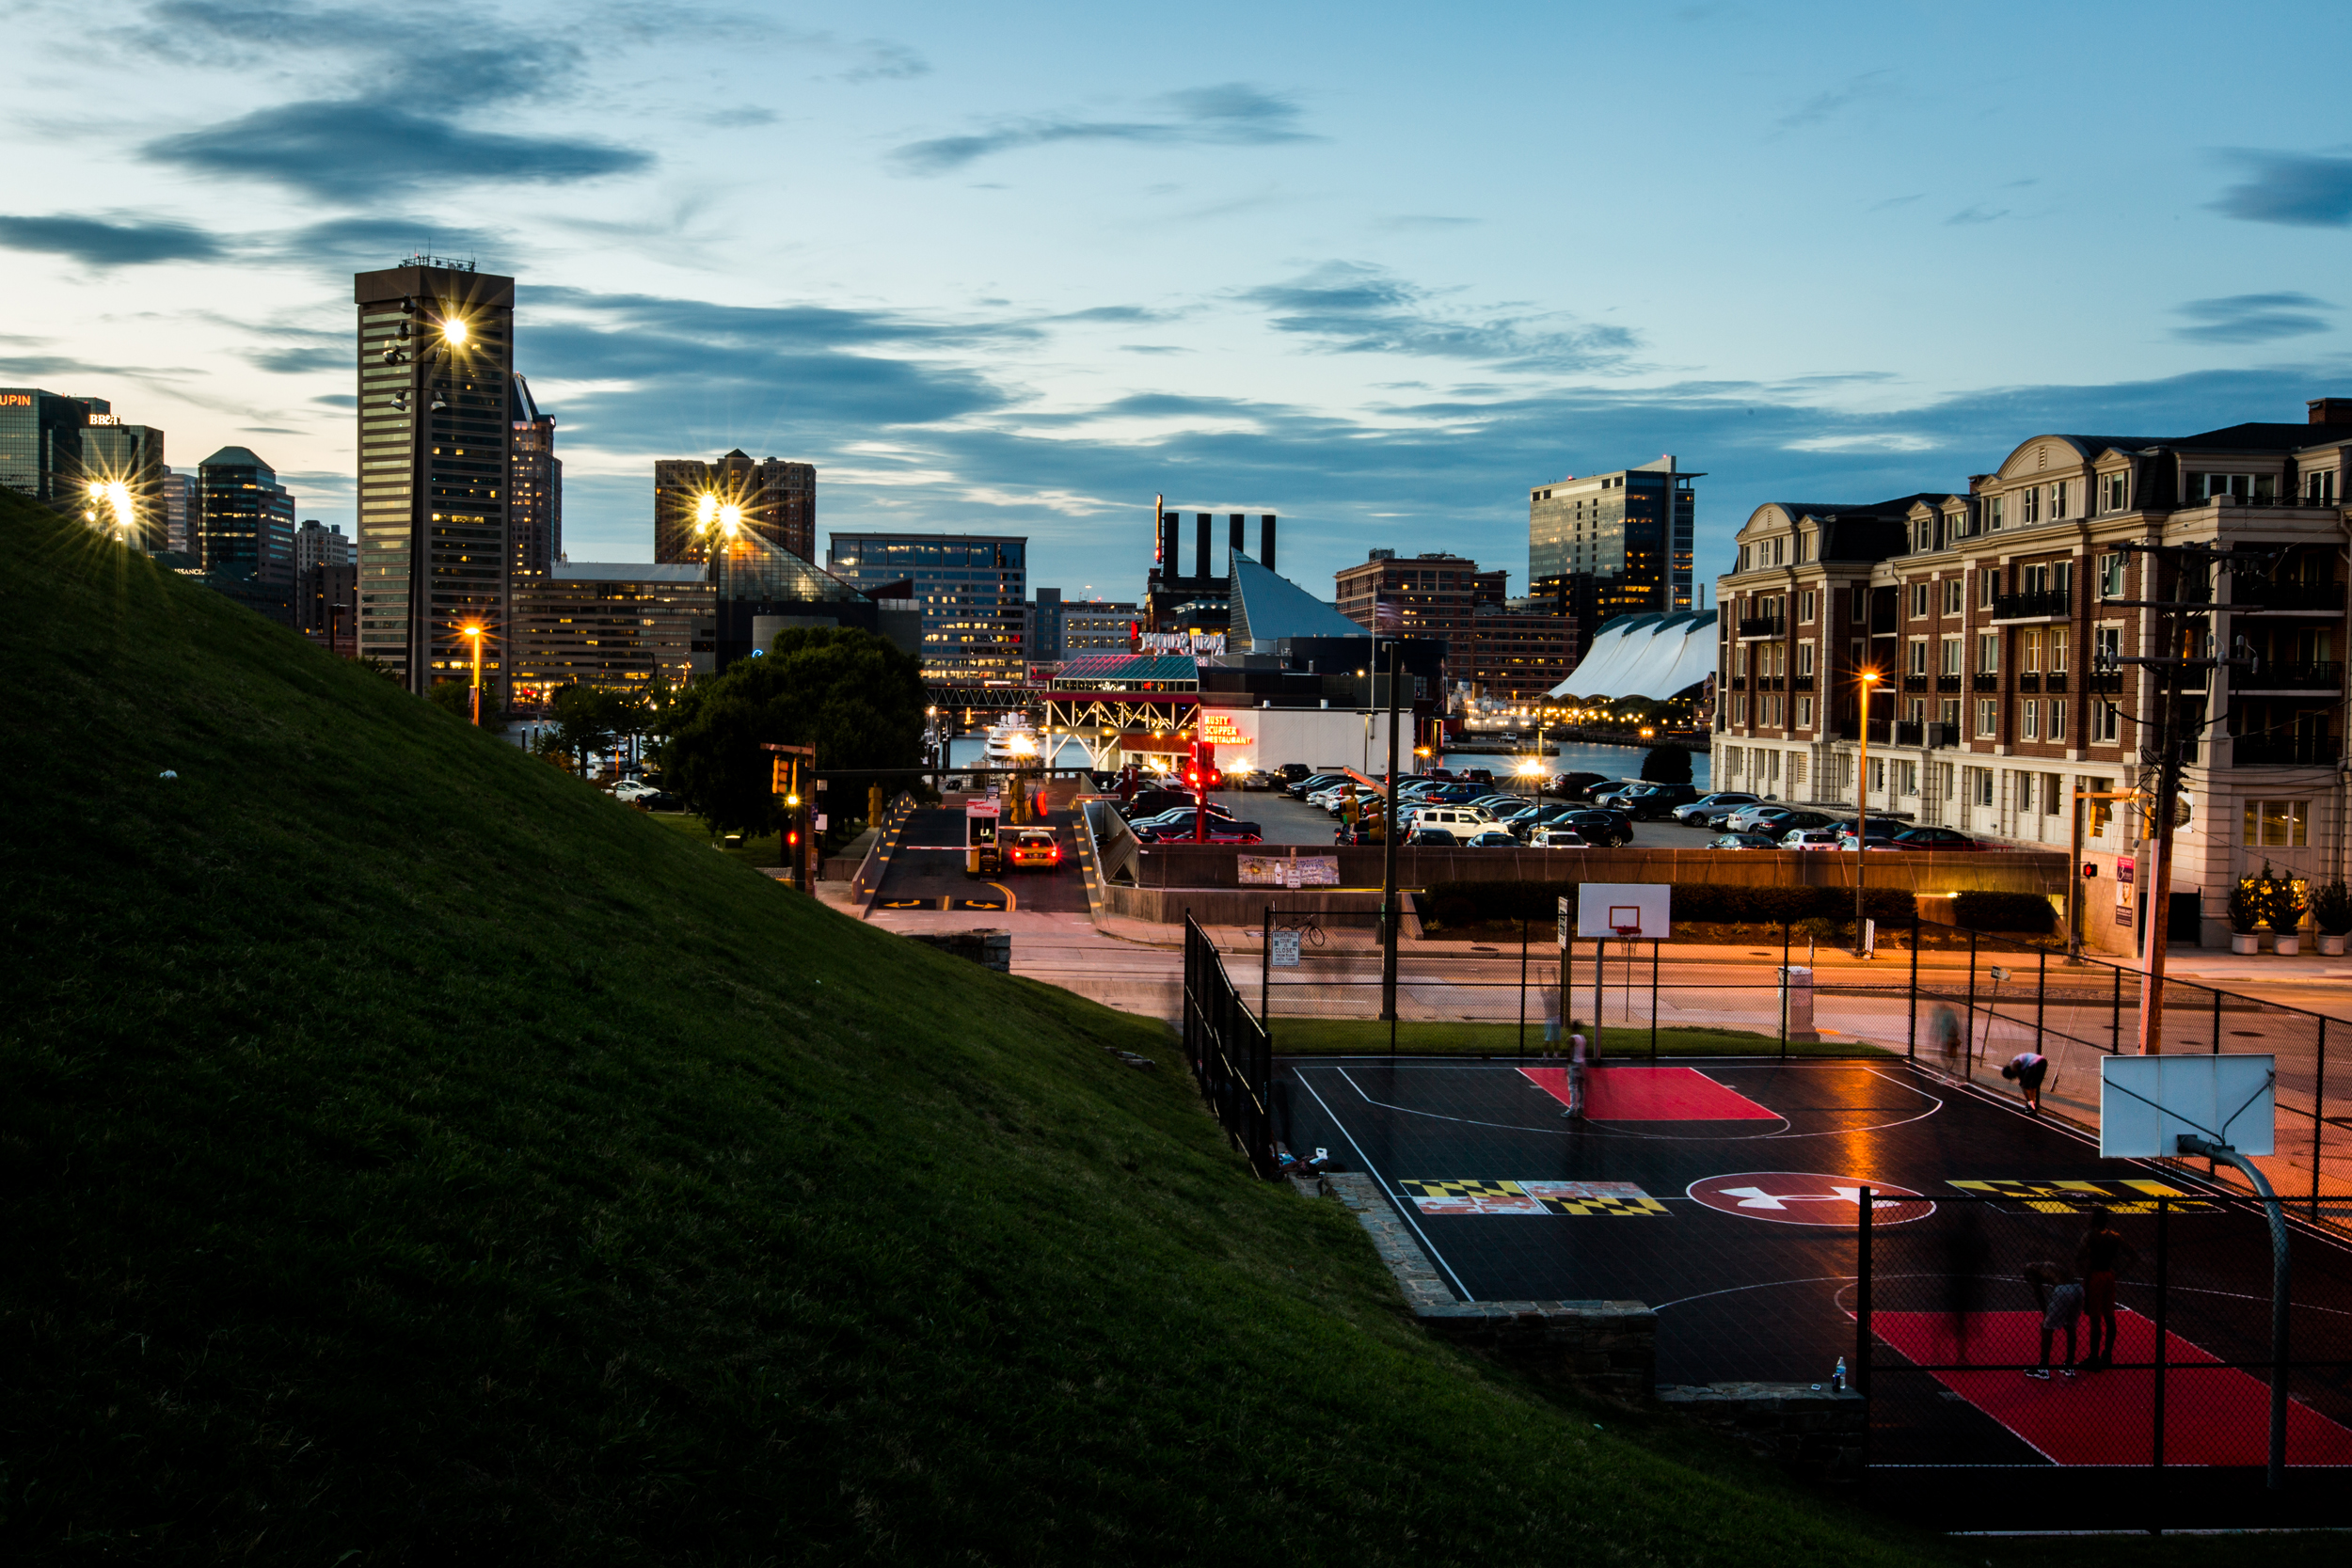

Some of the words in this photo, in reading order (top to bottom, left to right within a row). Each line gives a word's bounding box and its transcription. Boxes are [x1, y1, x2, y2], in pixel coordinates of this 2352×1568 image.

[89, 414, 120, 425] BB&T
[1204, 716, 1229, 725] RUSTY
[1204, 726, 1237, 736] SCUPPER
[1204, 736, 1251, 744] RESTAURANT
